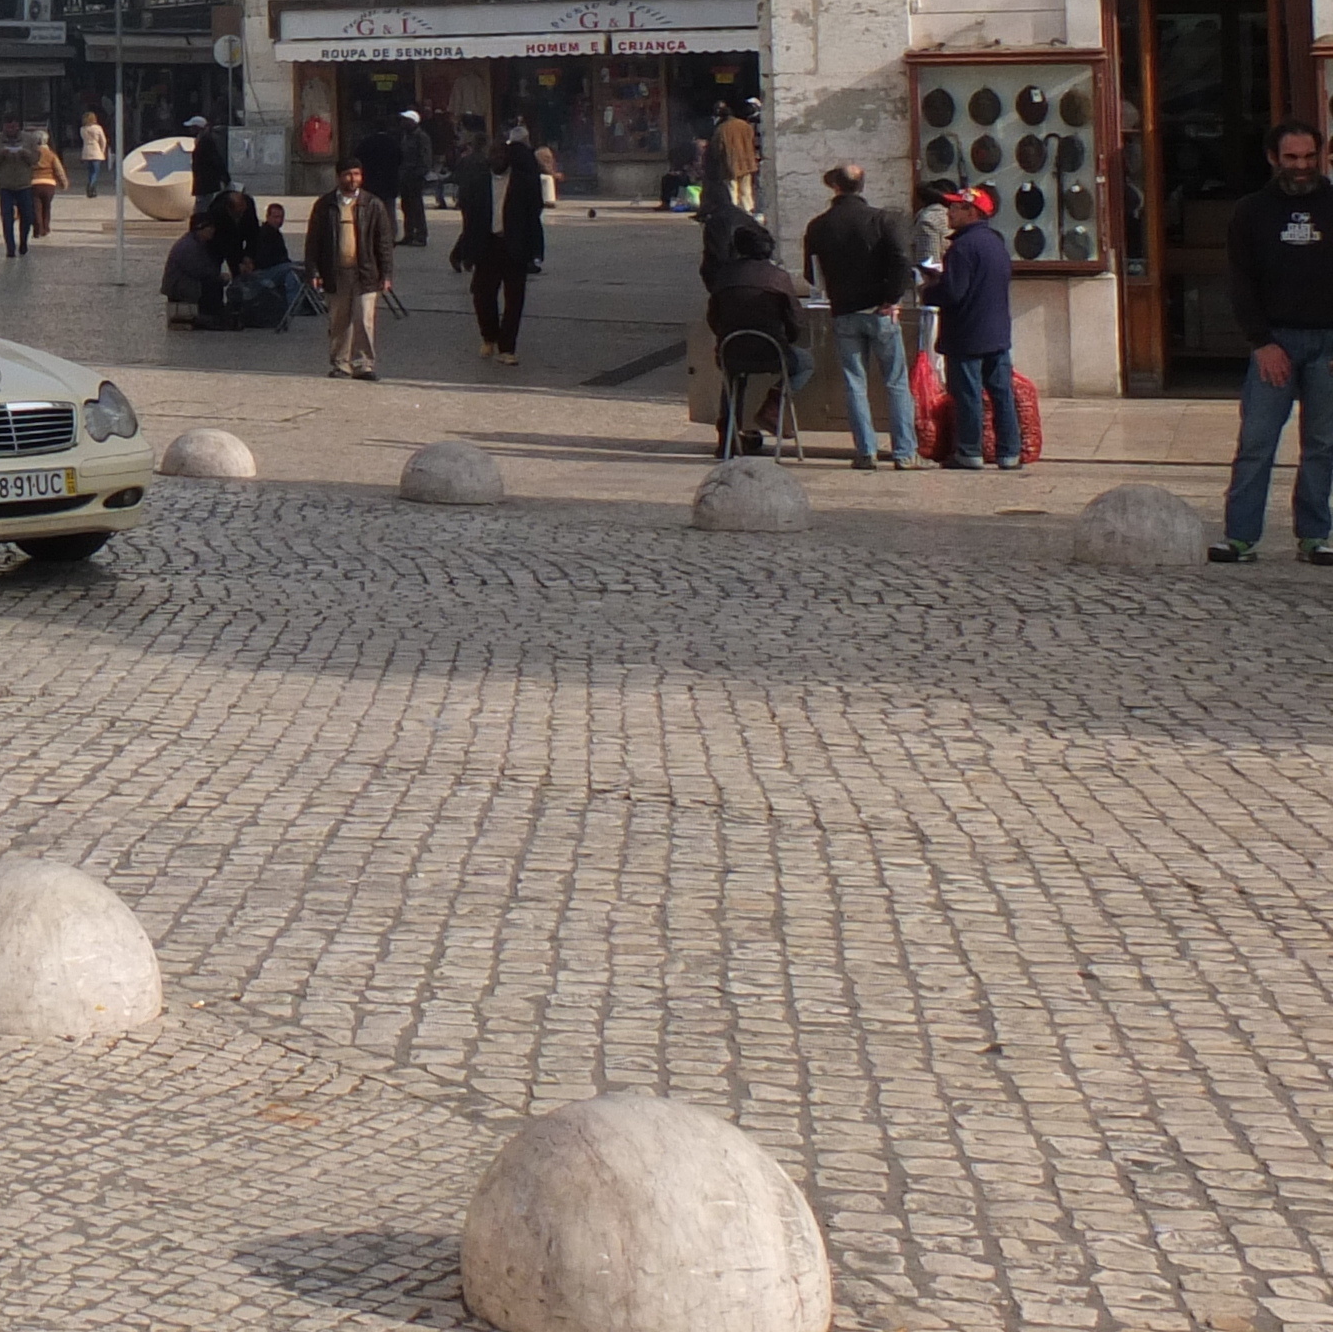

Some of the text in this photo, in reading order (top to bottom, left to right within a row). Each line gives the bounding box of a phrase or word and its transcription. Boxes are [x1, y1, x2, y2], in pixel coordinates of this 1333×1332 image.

[356, 18, 417, 36] G & L
[579, 11, 644, 29] G & L
[321, 40, 687, 59] ROUPA DE SENHORA HOMEM E CRIANÇA
